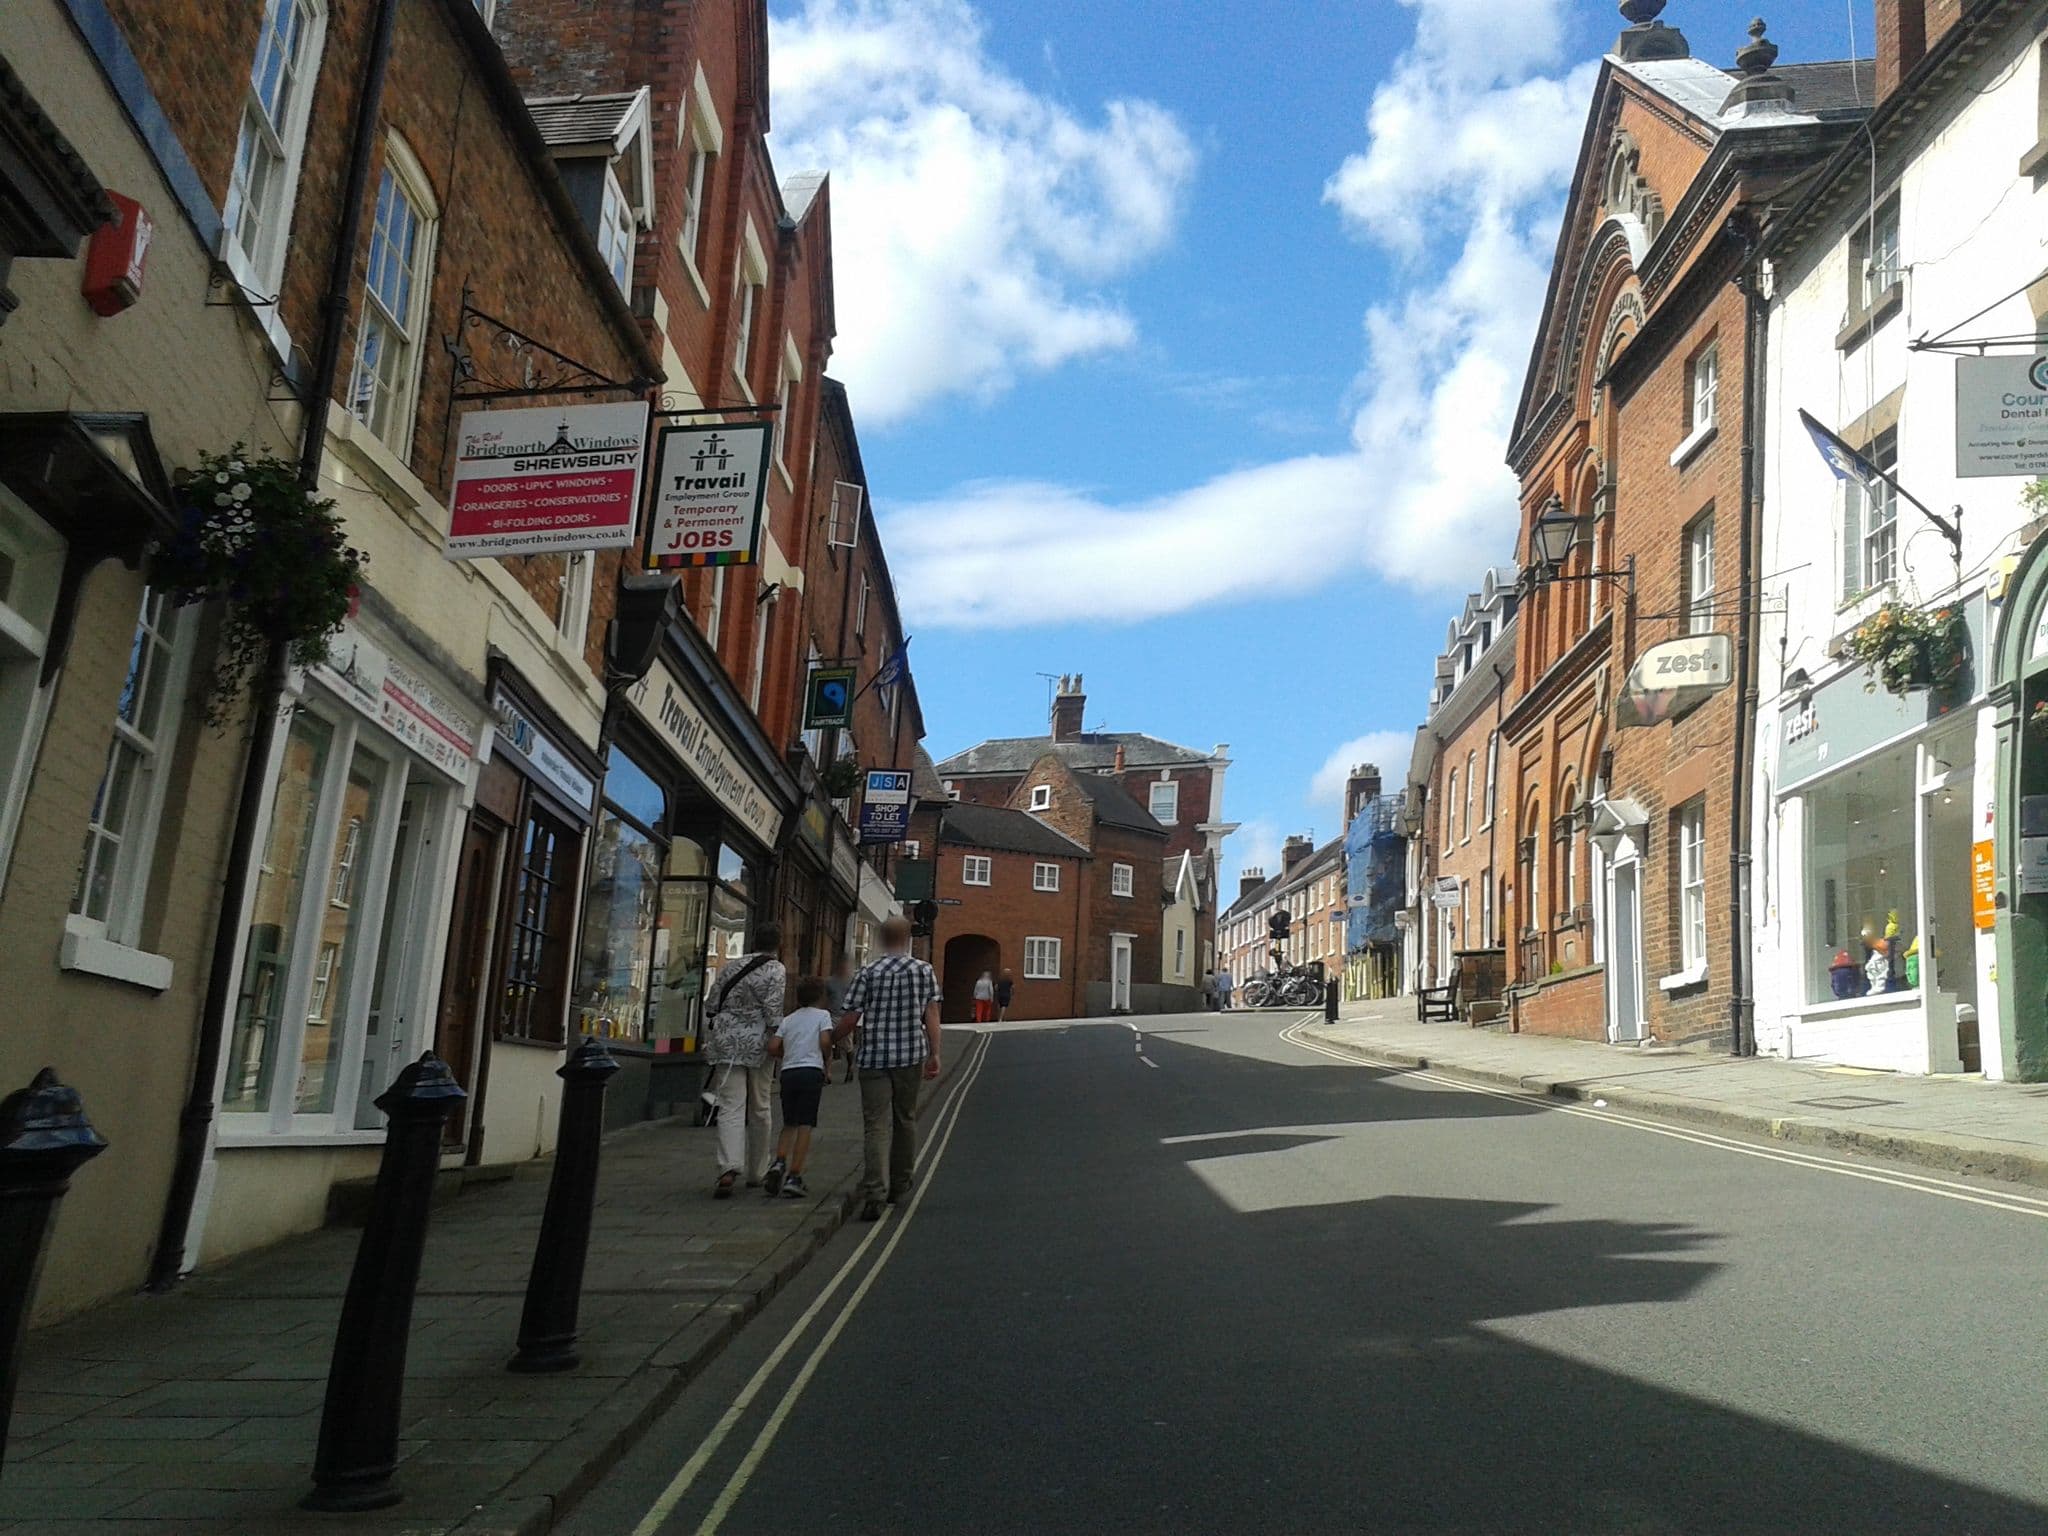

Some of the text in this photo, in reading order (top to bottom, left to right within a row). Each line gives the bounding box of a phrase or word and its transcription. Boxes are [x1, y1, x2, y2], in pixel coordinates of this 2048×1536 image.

[2001, 408, 2042, 419] Dental
[465, 432, 503, 444] The Real
[465, 435, 639, 457] Bridgnorth Windows
[513, 452, 638, 472] SHREWSBURY
[483, 476, 608, 493] DOORS UPVC WINDOWS
[674, 472, 746, 490] Travail
[462, 493, 622, 512] ORANGERIES CONSERVATORIES
[665, 490, 750, 502] Employment Group
[673, 504, 738, 516] Temporary
[492, 513, 591, 529] BI-FOLDING DOORS
[664, 515, 745, 529] & Permanent
[449, 530, 627, 549] www.bridgnorthwindows.co.uk
[668, 529, 733, 549] JOBS
[659, 682, 766, 830] Travail Employment Group
[870, 812, 901, 820] TO LET
[875, 804, 899, 812] SHOP
